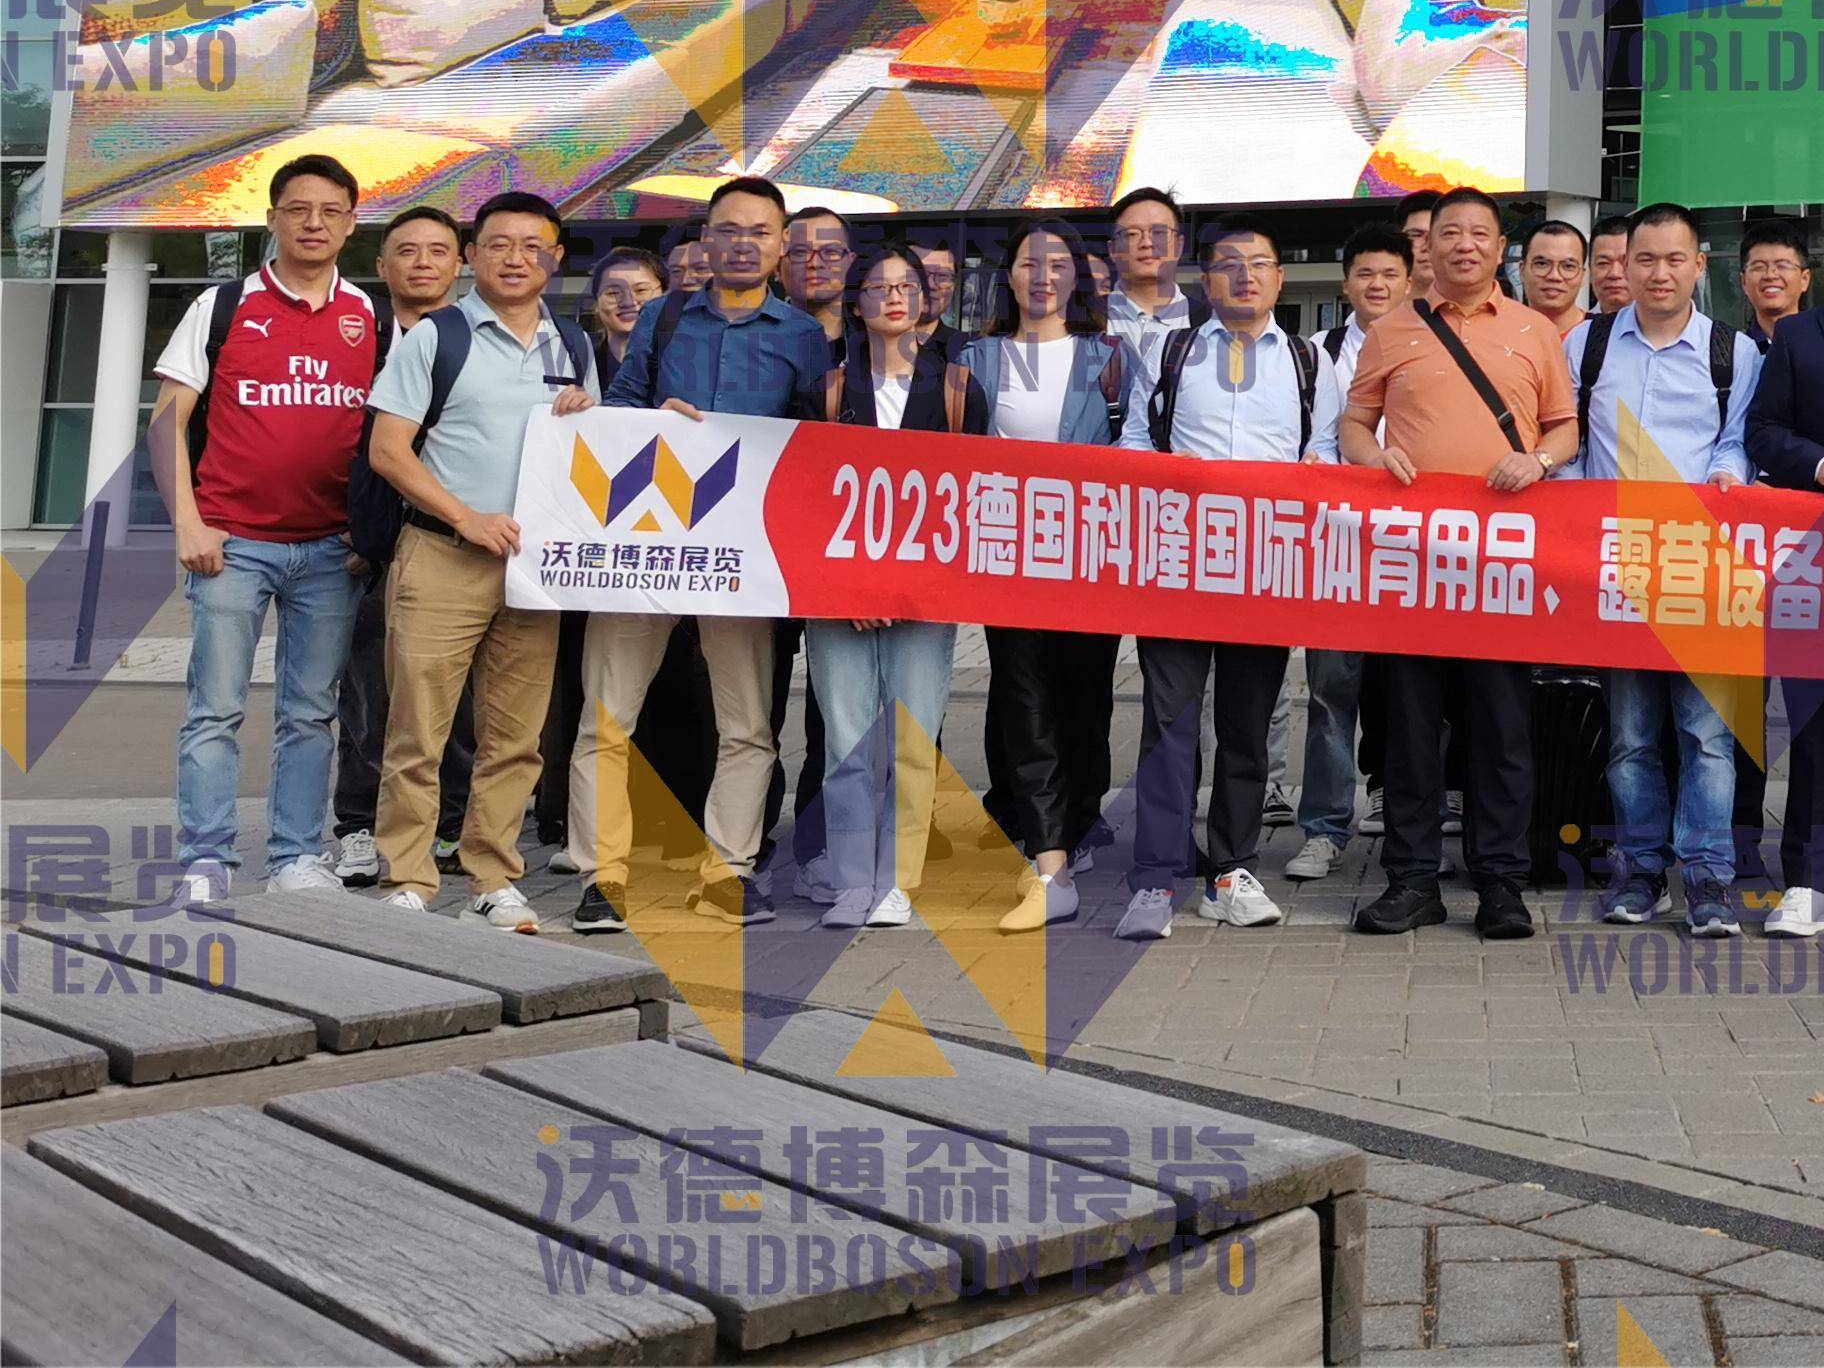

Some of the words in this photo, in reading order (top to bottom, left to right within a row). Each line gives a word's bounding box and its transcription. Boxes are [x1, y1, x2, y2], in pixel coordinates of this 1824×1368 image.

[288, 355, 328, 380] Fly
[237, 376, 366, 409] Emirates
[541, 540, 744, 574] 沃德博森展览
[540, 569, 681, 592] WORLDBOSON
[688, 574, 741, 593] EXPO
